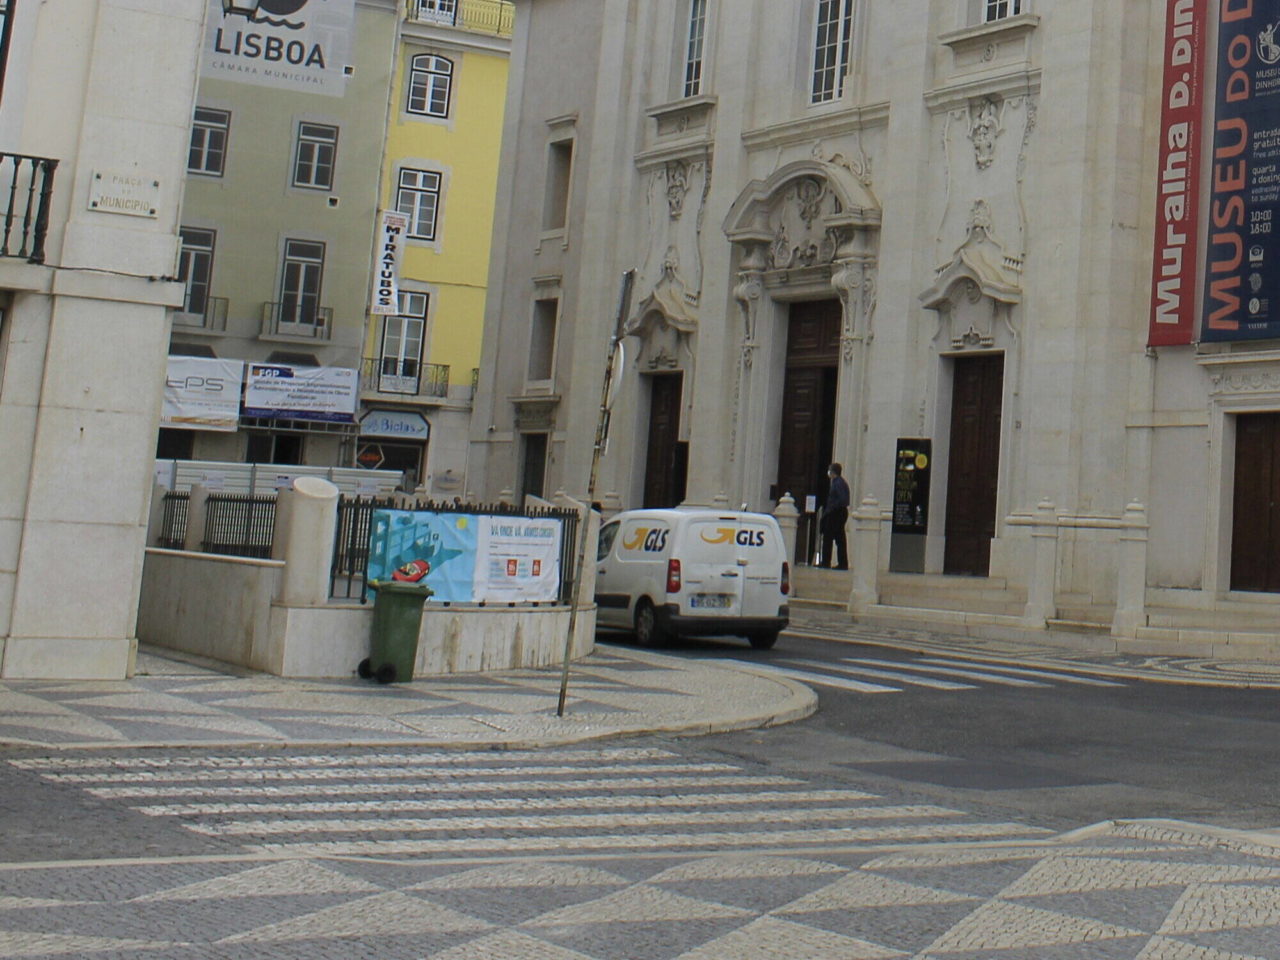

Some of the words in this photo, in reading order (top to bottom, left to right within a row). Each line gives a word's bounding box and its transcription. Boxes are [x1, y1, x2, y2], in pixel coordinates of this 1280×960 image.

[215, 28, 325, 69] LISBOA
[264, 69, 325, 85] MUNICIPAL
[1225, 34, 1250, 103] DO
[1256, 68, 1277, 79] MUSEU
[1169, 72, 1190, 110] D.
[1252, 164, 1276, 176] quarta
[1155, 122, 1188, 325] Muralha
[1208, 116, 1249, 332] MUSEU
[1250, 209, 1272, 222] 10:00
[379, 225, 401, 306] MIRATUBOS
[643, 528, 671, 552] GLS
[736, 529, 765, 547] GLS
